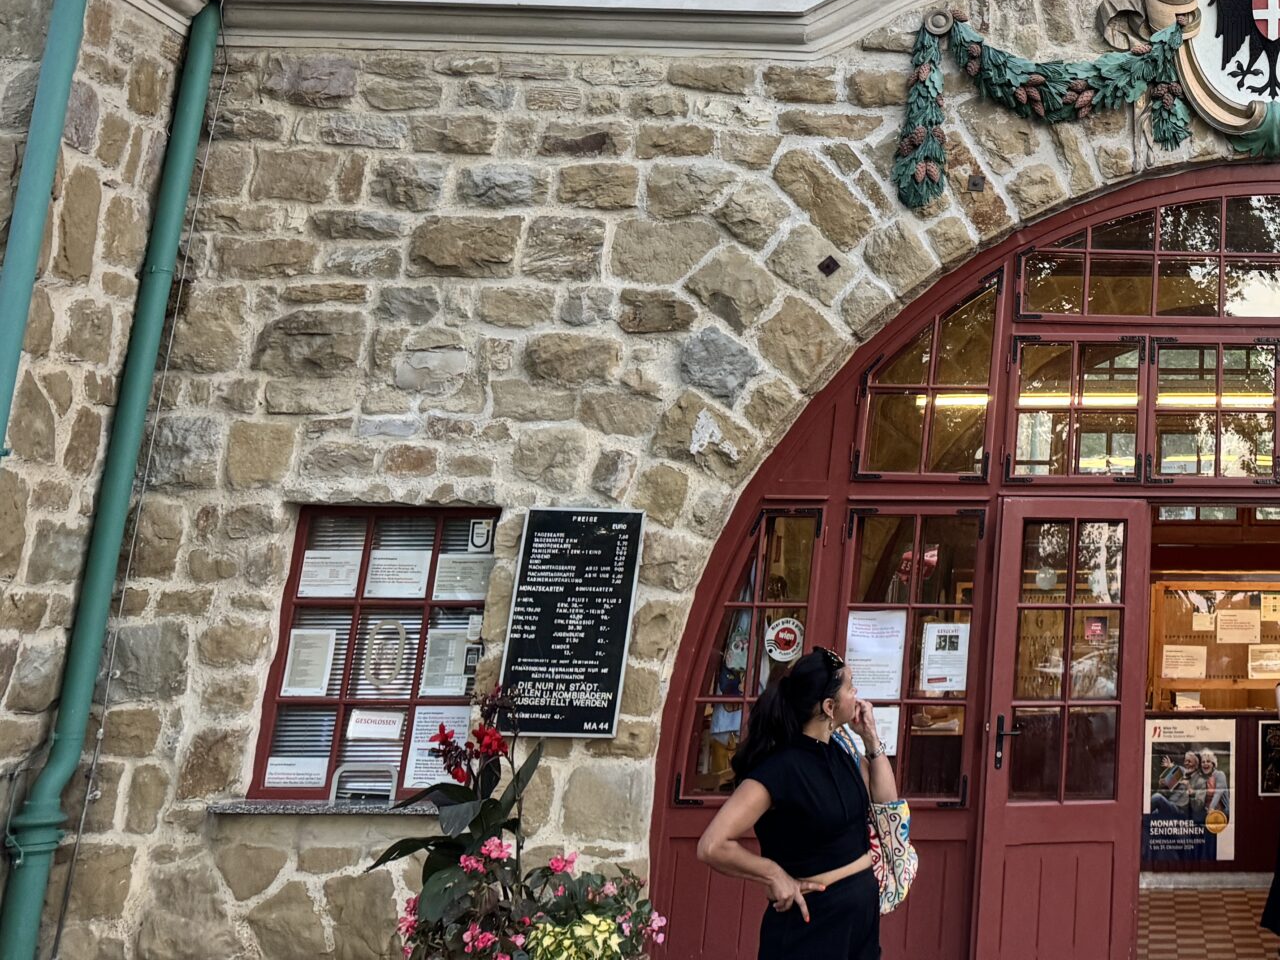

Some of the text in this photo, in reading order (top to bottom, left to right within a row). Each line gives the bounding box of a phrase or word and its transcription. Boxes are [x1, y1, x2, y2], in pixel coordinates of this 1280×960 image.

[517, 681, 534, 689] DIE
[535, 682, 554, 690] NUR
[555, 683, 566, 691] IN
[552, 691, 613, 700] KOMBIBÄDERN
[572, 699, 608, 708] WERDEN
[355, 718, 397, 726] GESCHLOSSEN
[583, 722, 609, 730] MA 44
[1150, 819, 1194, 827] MONAT DER
[1150, 827, 1205, 835] SENIOR:INNEN
